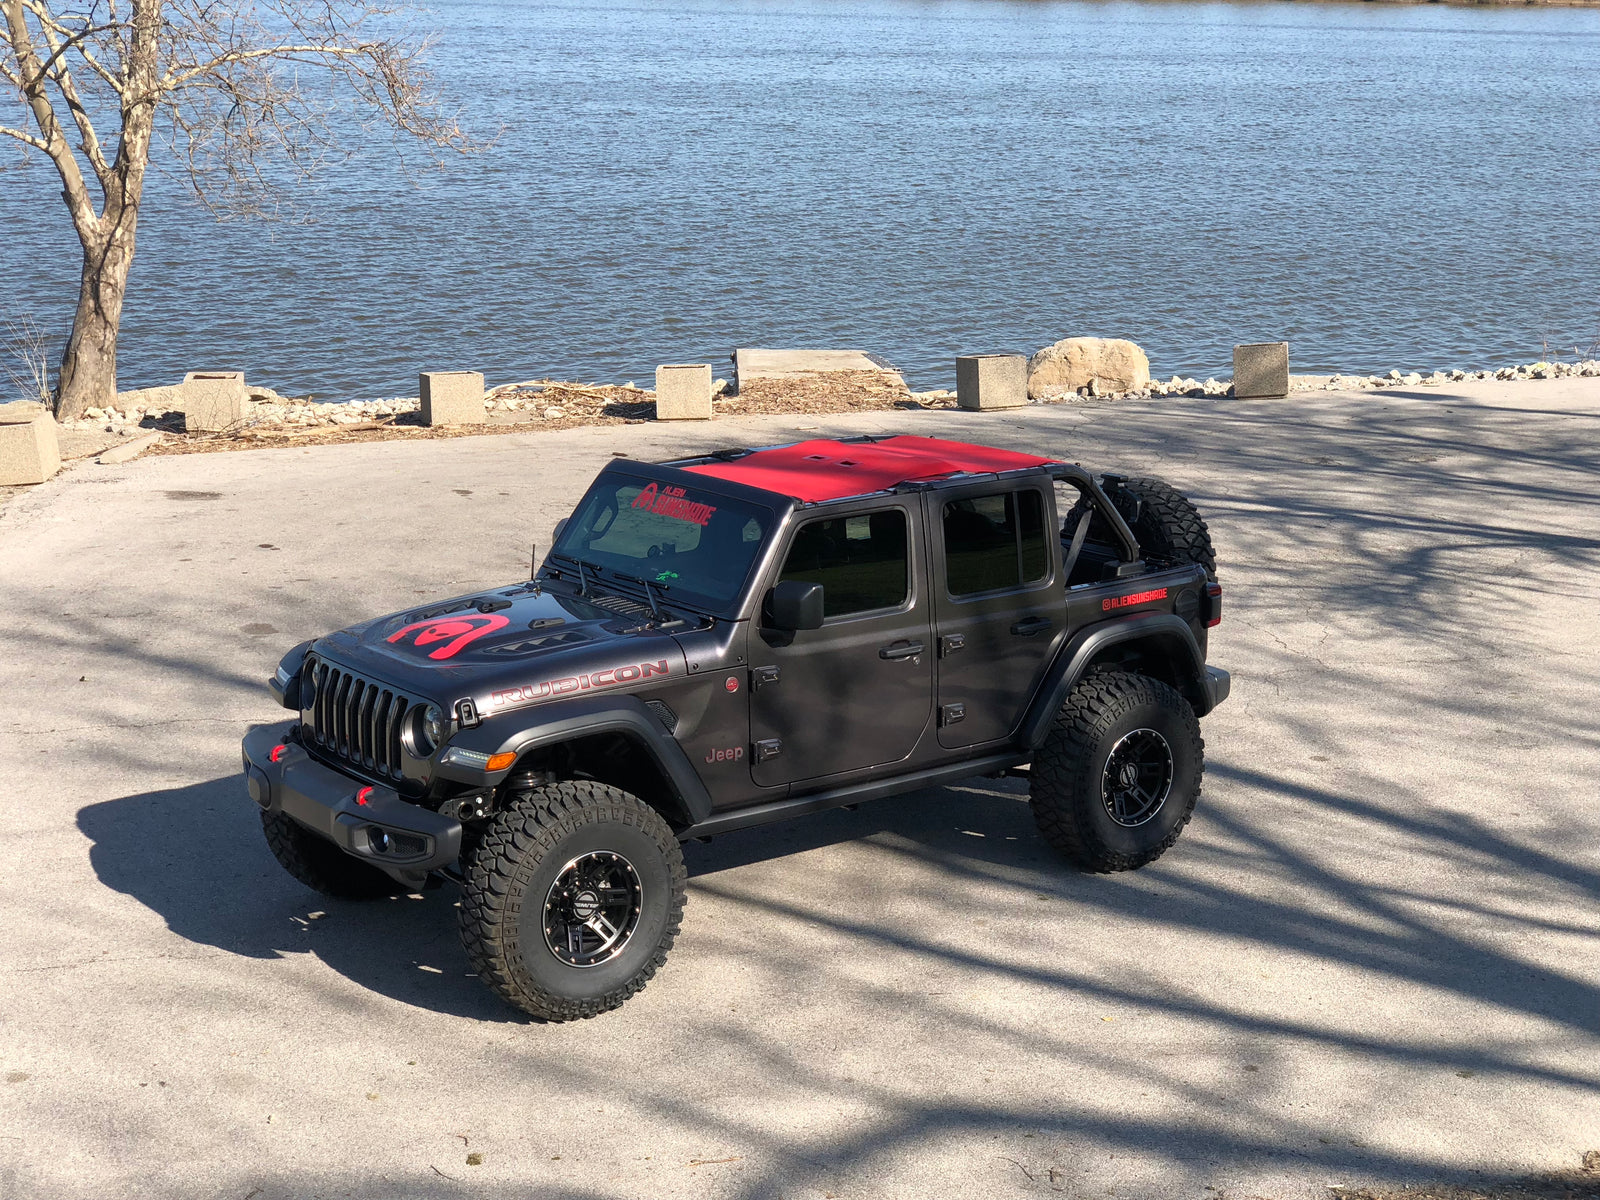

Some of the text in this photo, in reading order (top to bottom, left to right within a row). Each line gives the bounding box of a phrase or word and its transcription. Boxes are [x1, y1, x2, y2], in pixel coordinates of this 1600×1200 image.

[662, 486, 687, 498] ALIEN
[652, 495, 717, 526] SUNSHADE
[491, 659, 670, 706] RUBICON
[705, 745, 744, 765] Jeep
